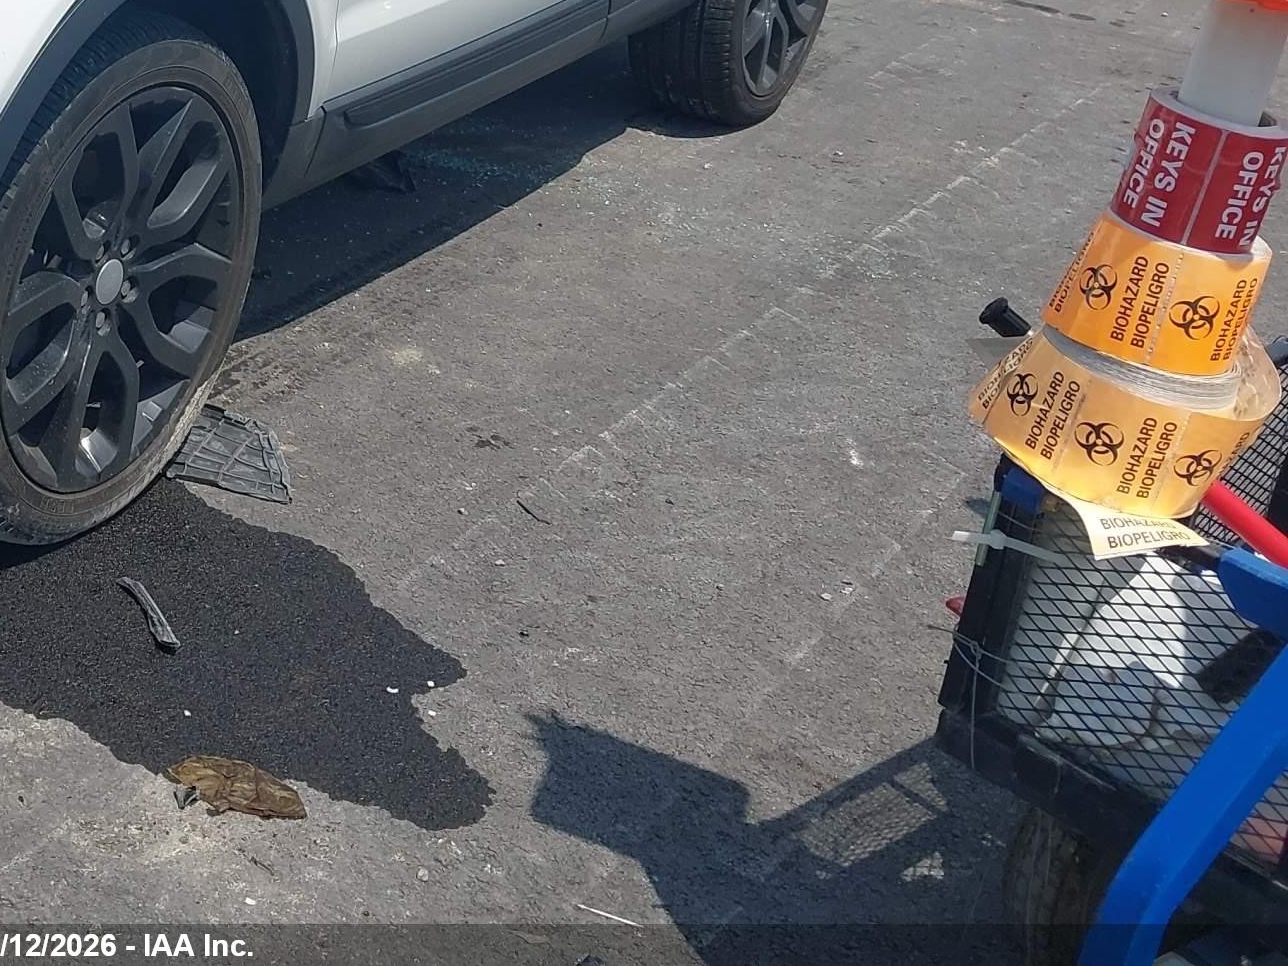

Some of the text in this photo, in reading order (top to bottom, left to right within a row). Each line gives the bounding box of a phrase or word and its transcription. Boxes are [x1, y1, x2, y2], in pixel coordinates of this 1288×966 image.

[1123, 118, 1165, 208] OFFICE
[1141, 122, 1196, 227] KEYS IN
[1215, 151, 1264, 240] OFFICE
[1239, 146, 1287, 246] KEYS IN
[1110, 255, 1149, 342] BIOHAZARD
[1131, 262, 1170, 348] BIOPELIGRO
[1210, 279, 1247, 361] BIOHAZARD
[1025, 371, 1065, 450] BIOHAZARD
[1040, 380, 1081, 460] BIOPELIGRO
[1116, 417, 1158, 495] BIOHAZARD
[1136, 421, 1178, 499] BIOPELIGRO
[1107, 530, 1191, 549] BIOPELIGRO
